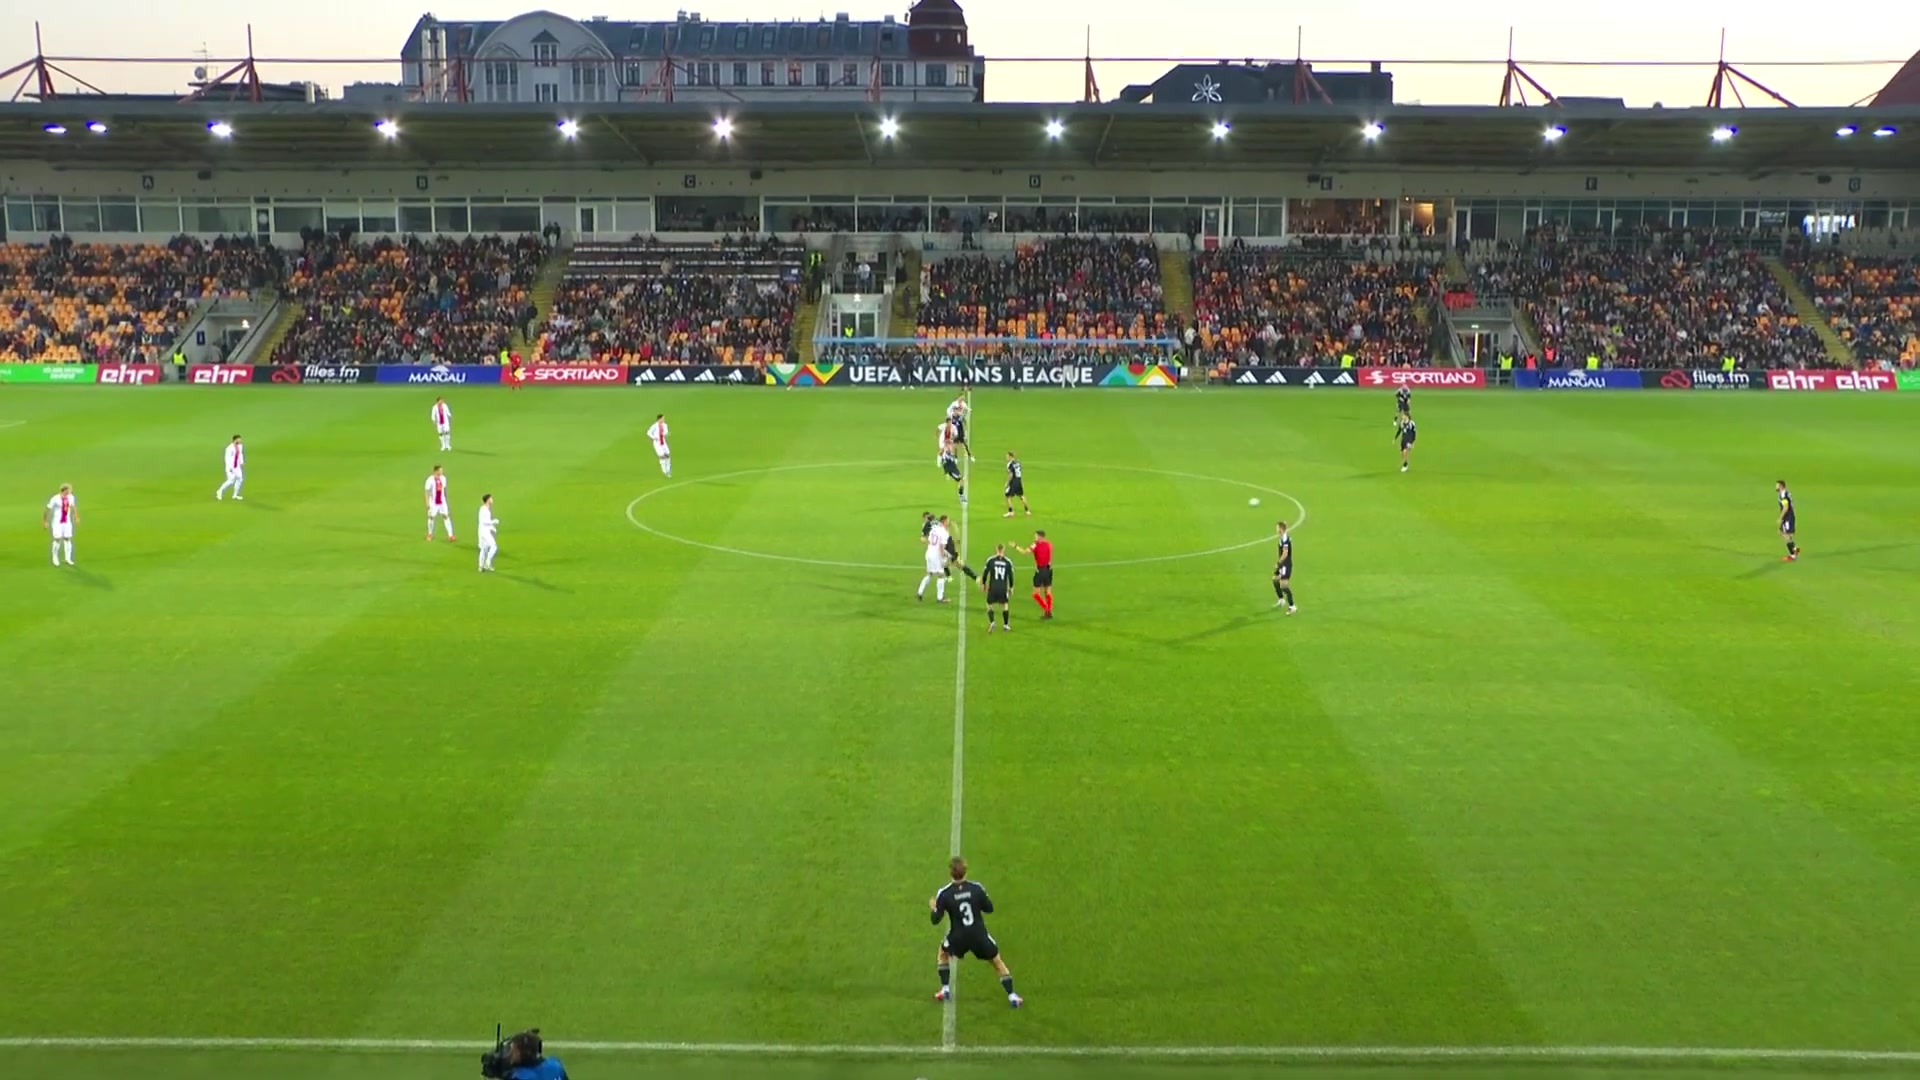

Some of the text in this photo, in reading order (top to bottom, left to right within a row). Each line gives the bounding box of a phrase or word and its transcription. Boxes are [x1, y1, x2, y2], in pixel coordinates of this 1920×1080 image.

[101, 364, 154, 383] ehr
[194, 364, 247, 383] ehr
[534, 368, 619, 380] SPORTLAND
[849, 366, 902, 382] UEFA
[1391, 371, 1476, 383] SPORTLAND
[1771, 370, 1825, 390] ehr
[1835, 370, 1889, 390] ehr
[994, 566, 1006, 580] 14
[959, 902, 974, 926] 3
